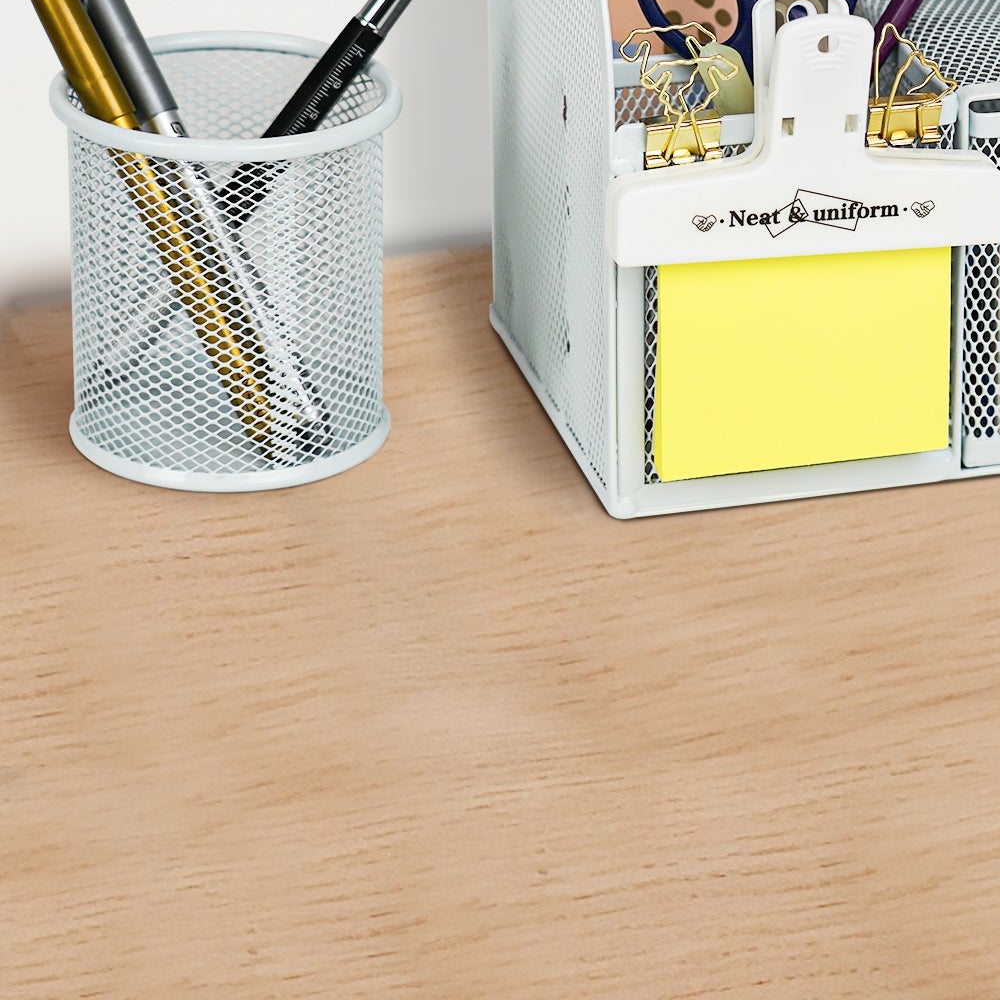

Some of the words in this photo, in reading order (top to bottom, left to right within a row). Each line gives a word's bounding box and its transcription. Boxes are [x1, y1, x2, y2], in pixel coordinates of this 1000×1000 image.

[729, 209, 780, 227] Neat
[789, 206, 806, 223] &
[813, 203, 899, 221] uniform
